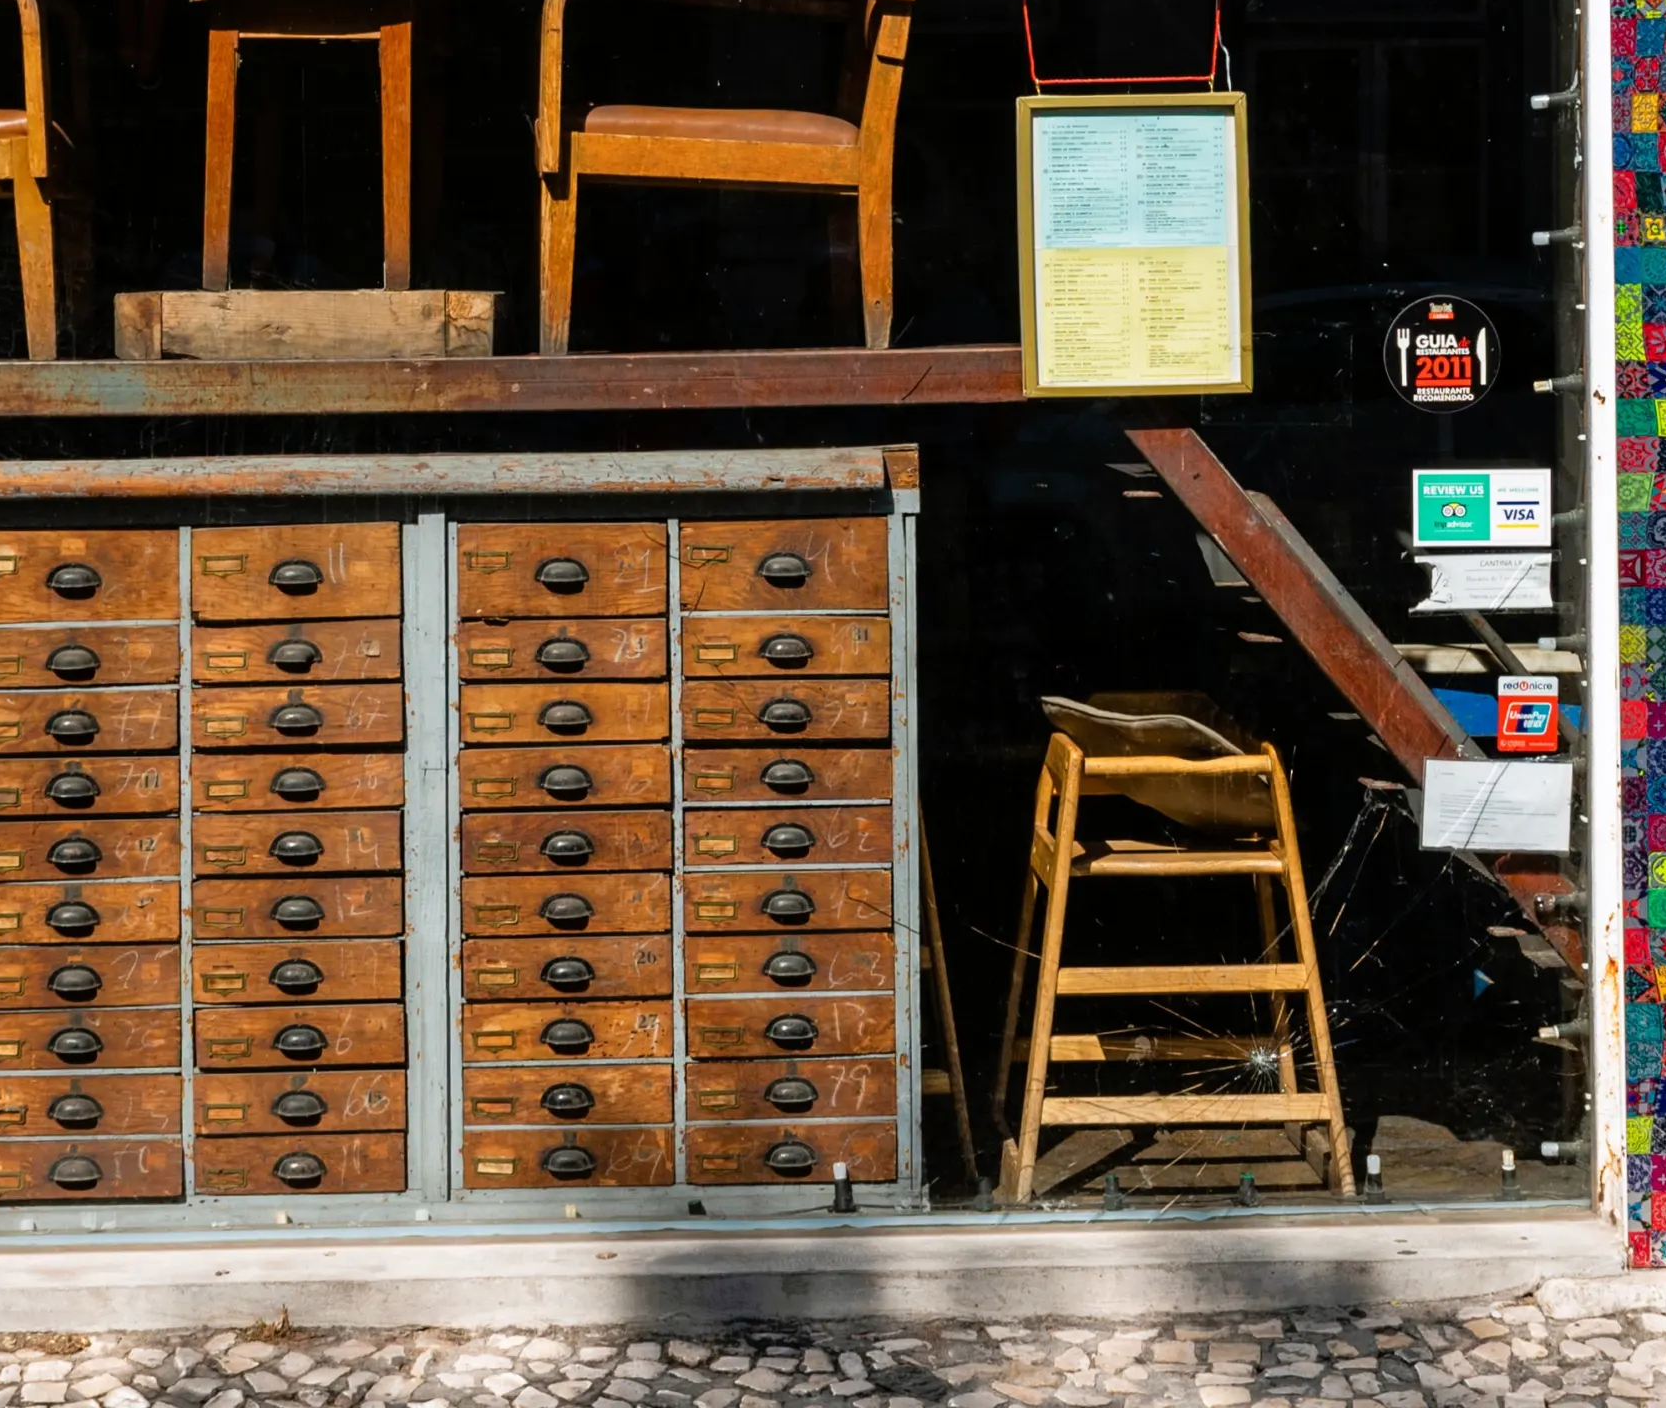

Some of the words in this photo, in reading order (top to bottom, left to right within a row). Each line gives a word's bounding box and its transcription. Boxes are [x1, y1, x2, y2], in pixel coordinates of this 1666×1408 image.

[1415, 334, 1459, 349] GUIA
[1415, 347, 1471, 356] RESTAURANTES
[1416, 355, 1472, 379] 2011
[1413, 394, 1475, 402] RECOMENDADO
[1416, 387, 1471, 395] RESTAURANTE
[1422, 485, 1467, 496] REVIEW
[1469, 485, 1485, 496] US
[1503, 509, 1535, 520] VISA
[344, 828, 381, 869] 14
[636, 950, 657, 964] 26
[637, 1014, 657, 1028] 27
[335, 1008, 353, 1055] 6
[828, 1064, 872, 1111] 79
